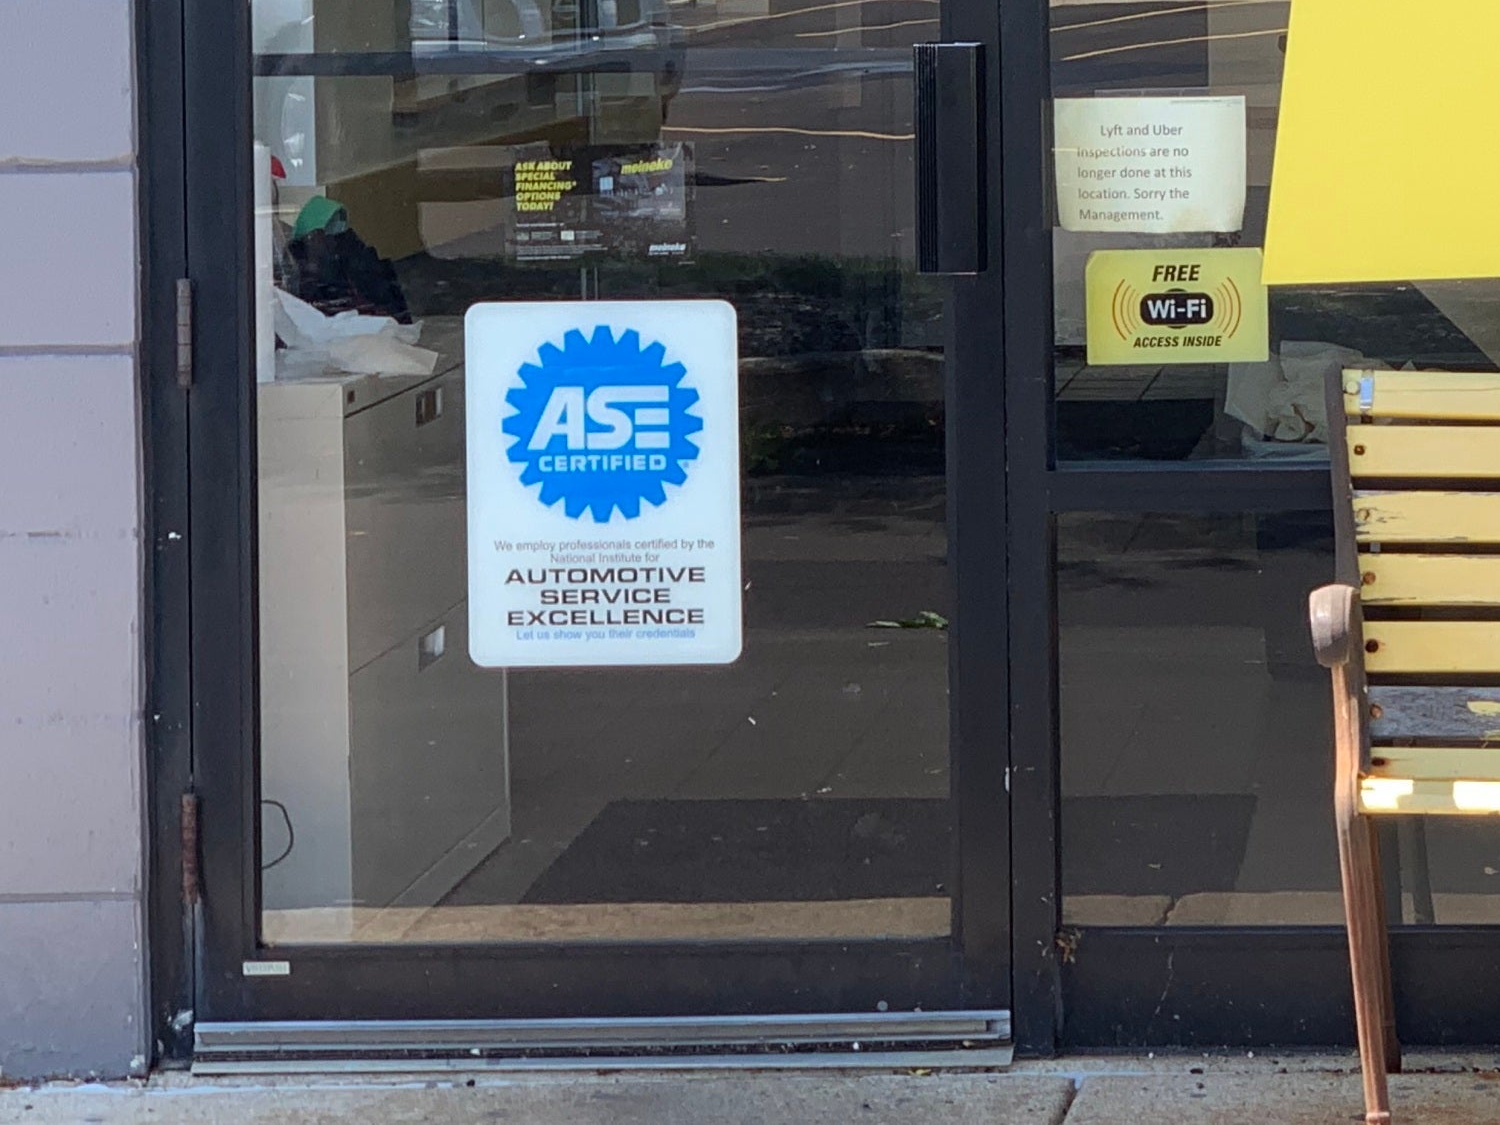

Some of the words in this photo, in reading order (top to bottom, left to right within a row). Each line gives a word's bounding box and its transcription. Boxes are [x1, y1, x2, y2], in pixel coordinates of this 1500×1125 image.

[1100, 124, 1123, 138] Lyft
[1126, 124, 1149, 135] and
[1153, 124, 1183, 136] Uber
[1149, 147, 1169, 157] are
[1173, 147, 1189, 157] no
[515, 161, 537, 172] ASK
[537, 161, 572, 171] ABOUT
[1077, 166, 1116, 180] longer
[1120, 166, 1150, 178] done
[1154, 168, 1167, 178] at
[1169, 166, 1192, 178] this
[515, 172, 556, 181] SPECIAL
[516, 192, 561, 202] OPTIONS
[1078, 188, 1131, 199] location.
[1133, 188, 1166, 201] Sorry
[1169, 187, 1190, 199] the
[1079, 209, 1164, 222] Management.
[1152, 264, 1201, 282] FREE
[1146, 299, 1208, 319] Wi-Fi
[1133, 336, 1179, 348] ACCESS
[1182, 335, 1222, 347] INSIDE
[526, 385, 671, 451] ASE
[537, 454, 668, 472] CERTIFIED
[494, 540, 513, 551] We
[516, 541, 556, 553] employ
[559, 540, 631, 552] professionals
[634, 540, 678, 550] certified
[681, 539, 695, 551] by
[698, 539, 715, 550] the
[550, 553, 595, 563] National
[599, 553, 641, 563] Institute
[645, 552, 660, 563] for
[504, 567, 706, 584] AUTOMOTIVE
[540, 588, 671, 605] SERVICE
[507, 608, 705, 626] EXCELLENCE
[516, 630, 534, 641] Let
[537, 631, 549, 640] us
[553, 630, 582, 640] show
[585, 631, 606, 642] you
[608, 628, 632, 639] their
[635, 627, 696, 639] credentials
